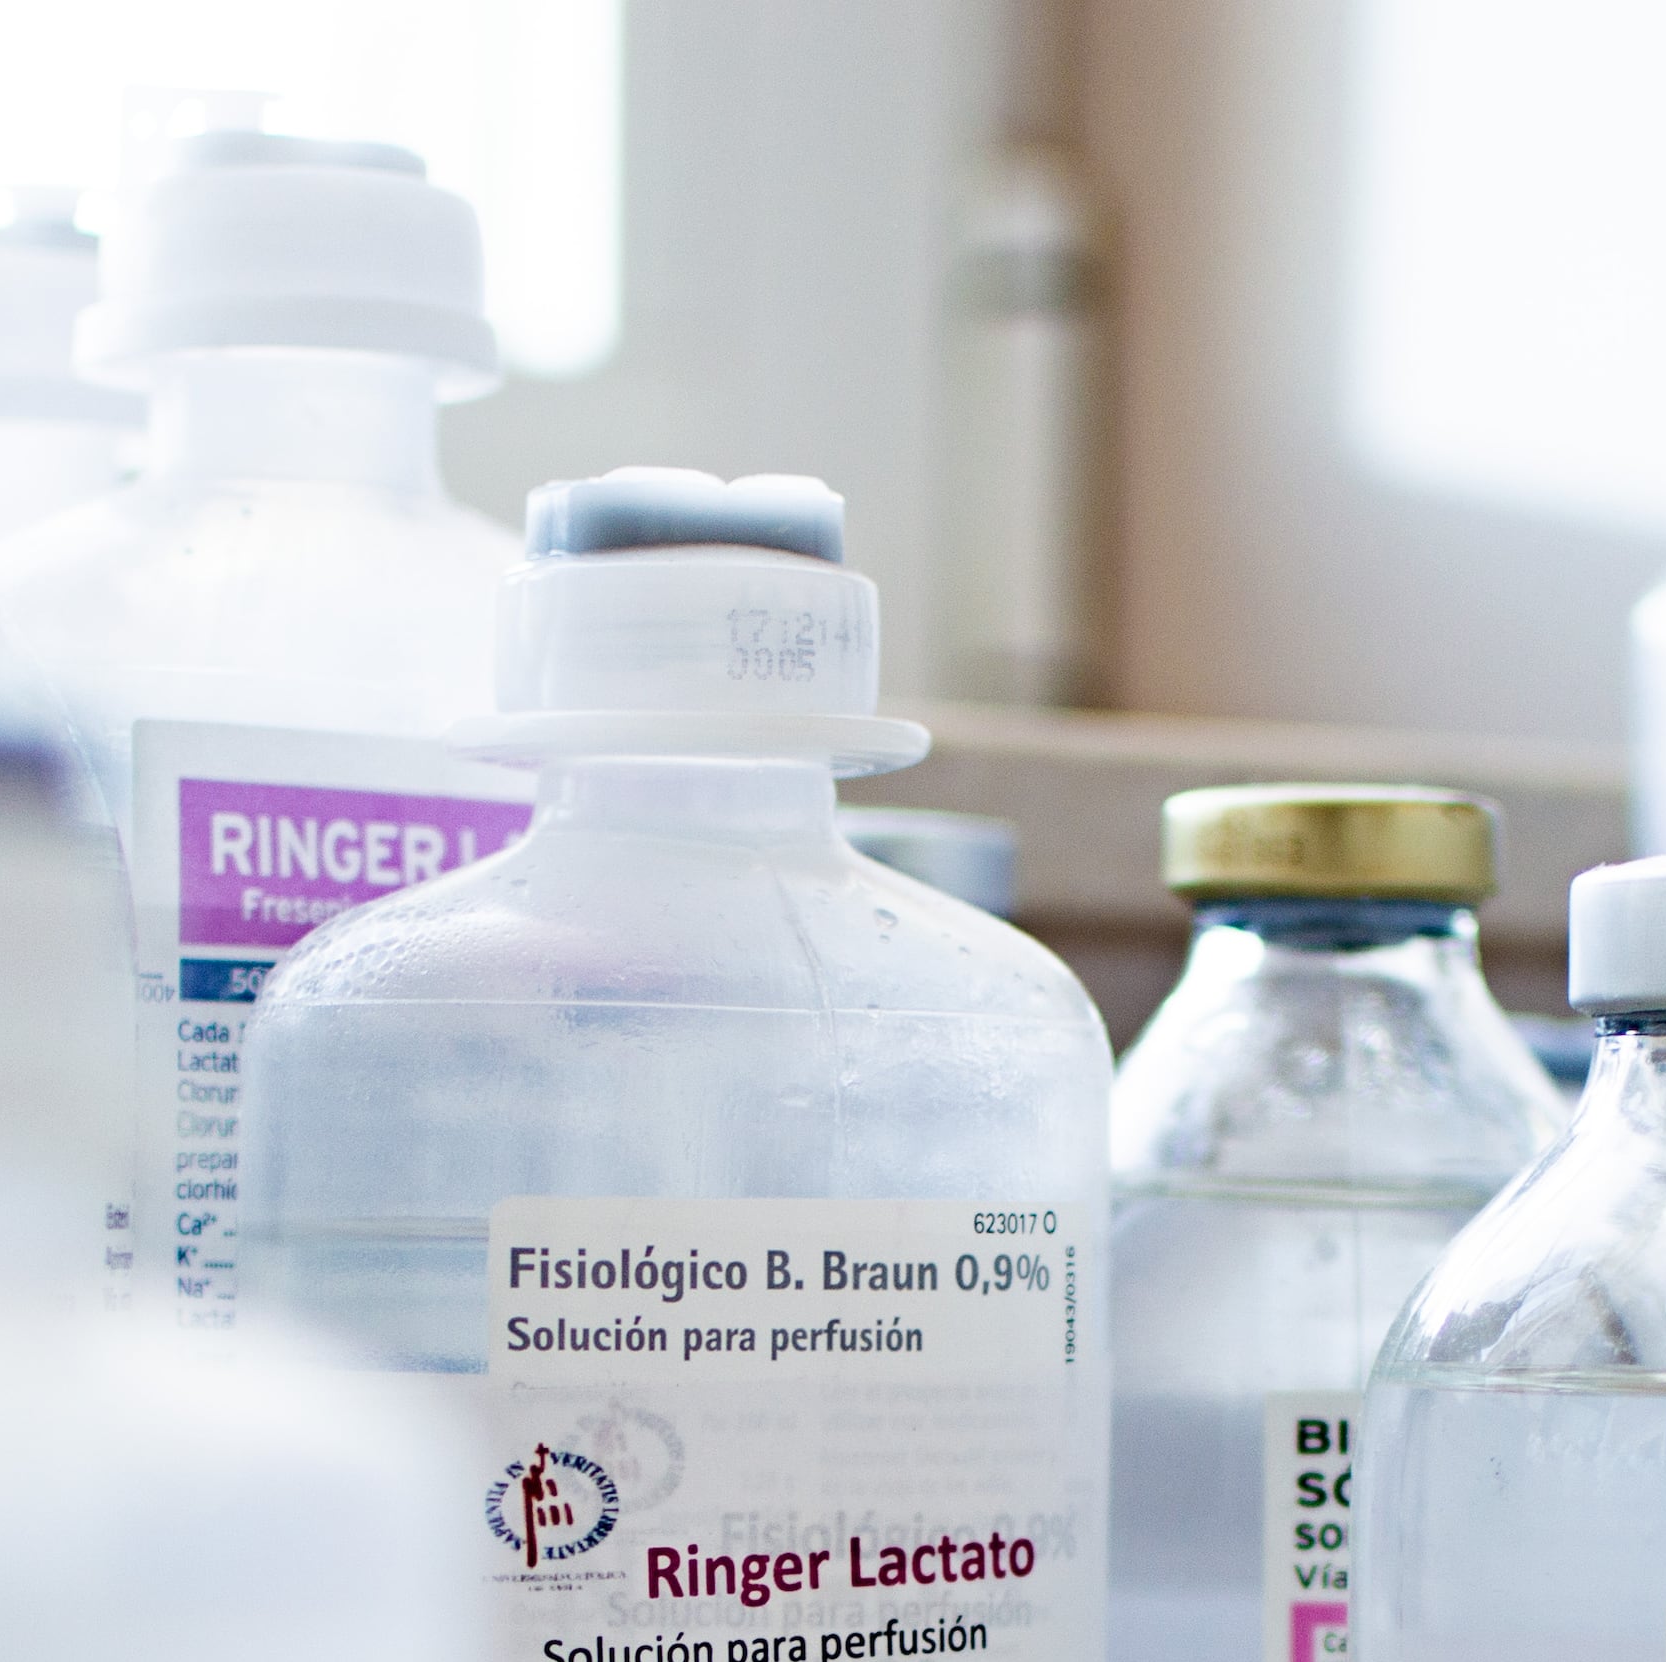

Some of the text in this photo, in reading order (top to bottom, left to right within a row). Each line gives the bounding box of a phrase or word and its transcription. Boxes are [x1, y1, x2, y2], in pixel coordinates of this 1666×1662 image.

[211, 811, 446, 887] RINGER
[178, 1020, 230, 1044] Cada
[973, 1212, 1038, 1235] 623017
[509, 1245, 1051, 1302] Fisiológico B. Braun 0,9%
[507, 1314, 924, 1360] Solución para perfusión
[648, 1532, 1036, 1608] Ringer Lactato
